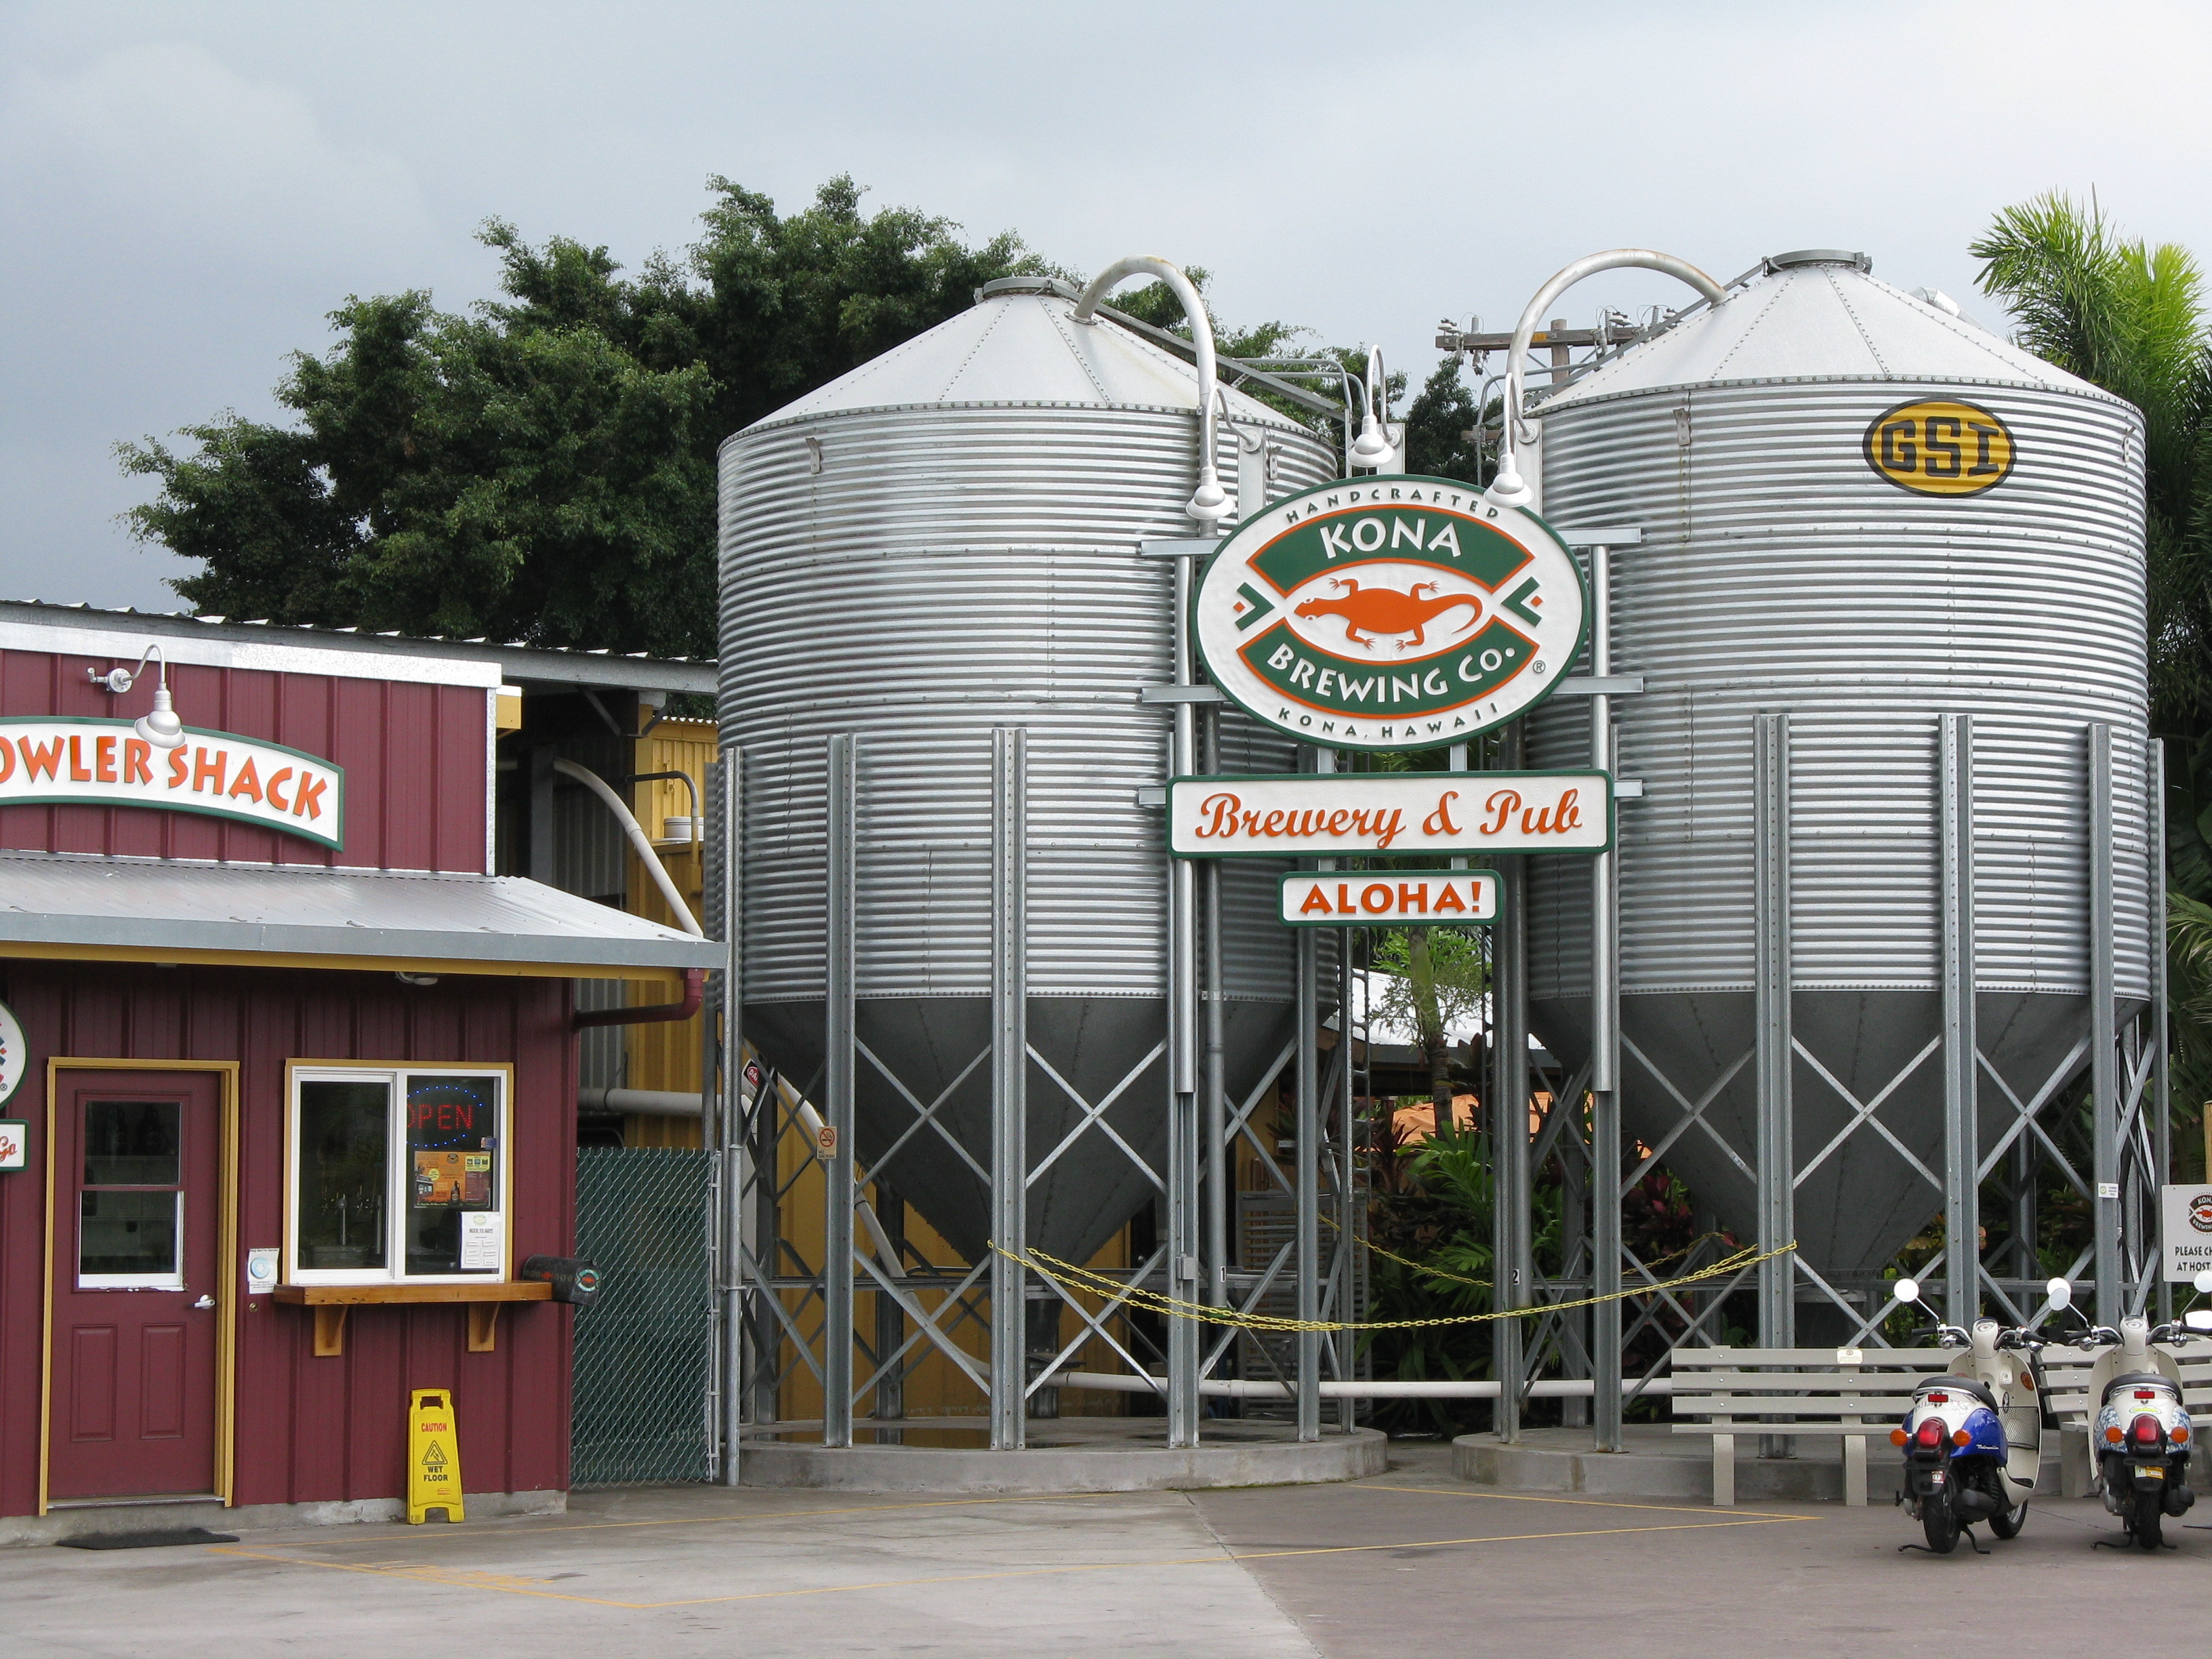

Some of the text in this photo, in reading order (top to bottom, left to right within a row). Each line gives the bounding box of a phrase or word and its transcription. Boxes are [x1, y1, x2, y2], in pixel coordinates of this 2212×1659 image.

[1881, 416, 1999, 478] GSI
[1286, 488, 1498, 523] HANDCRAFTED
[1319, 515, 1462, 559] KONA
[1267, 642, 1450, 703] BREWING
[1279, 702, 1498, 739] KONA, HAWAII
[168, 743, 328, 821] SHACK
[1195, 788, 1583, 849] Brewery & Pub
[1300, 882, 1482, 915] ALOHA!
[2175, 1246, 2203, 1256] PLEASE
[2176, 1261, 2211, 1271] AT HOST
[421, 1422, 447, 1433] CAUTION
[424, 1474, 449, 1482] FLOOR
